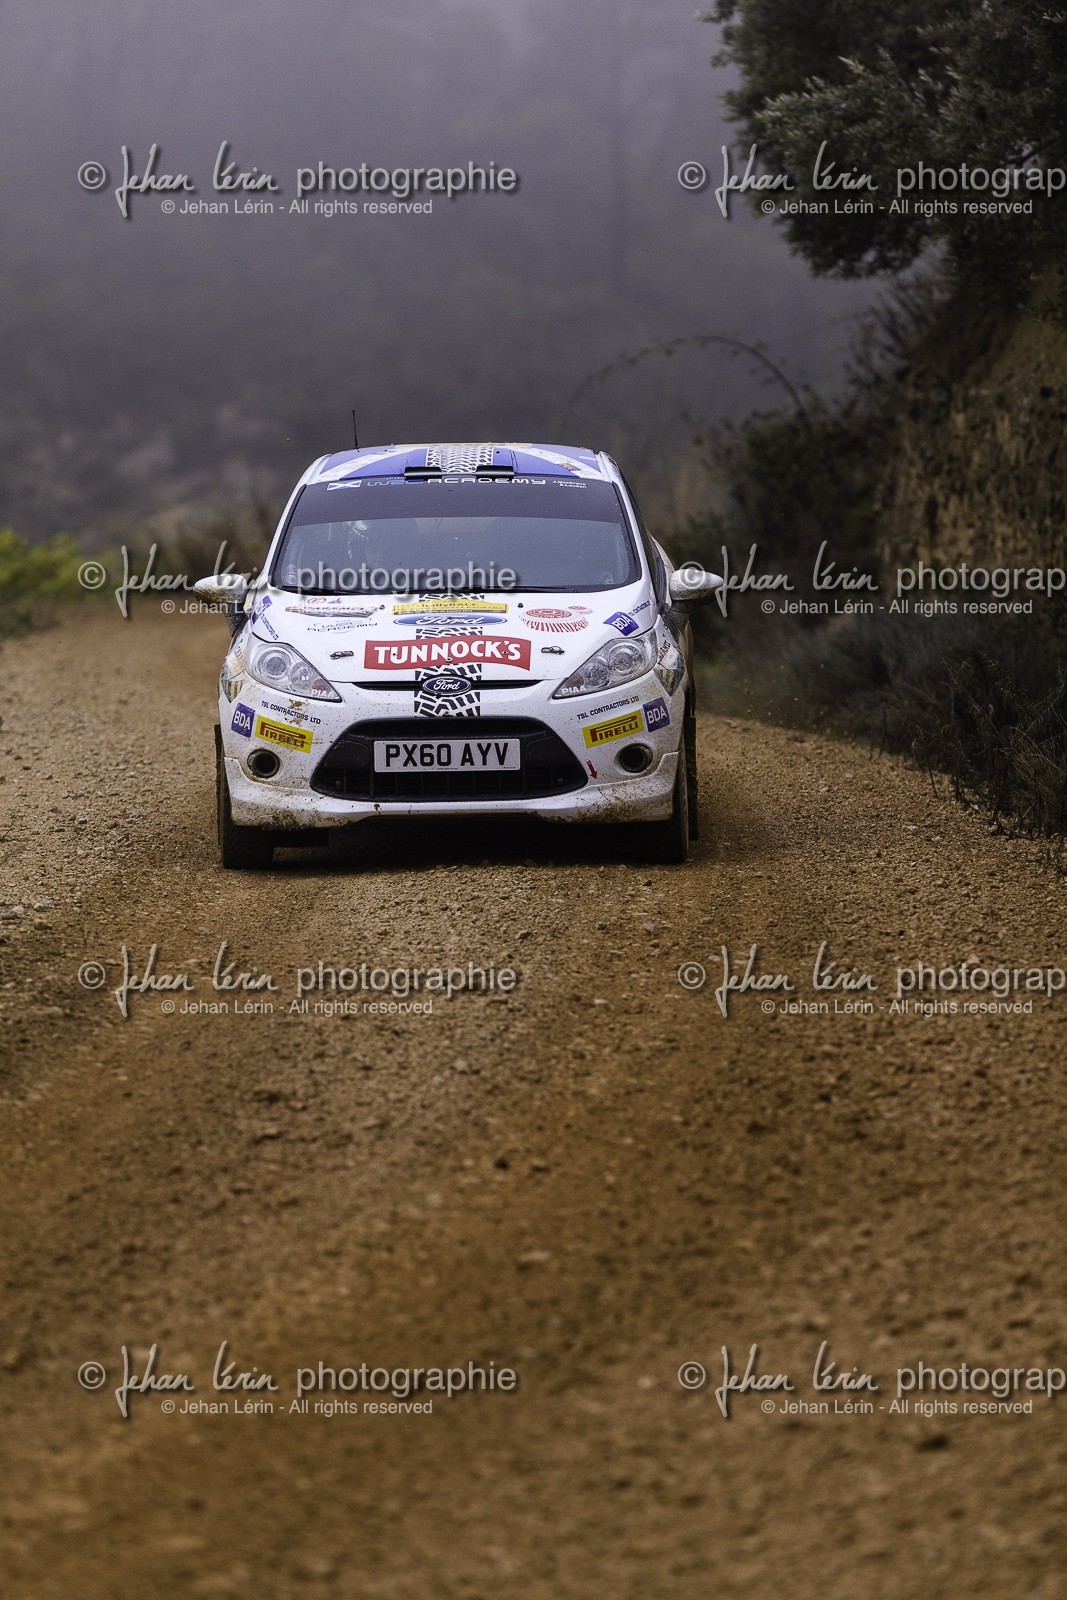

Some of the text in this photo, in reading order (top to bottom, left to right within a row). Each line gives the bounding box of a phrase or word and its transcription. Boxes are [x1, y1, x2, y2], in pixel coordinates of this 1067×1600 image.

[428, 476, 546, 484] ACADEMY
[416, 614, 485, 625] Ford
[611, 614, 633, 630] BDA
[374, 640, 521, 665] TUNNOCK'S
[434, 679, 461, 690] Ford
[561, 685, 588, 695] PIAA
[261, 700, 321, 725] TSL CONTRACTORS LTD
[590, 698, 630, 716] CONTRACTORS
[630, 695, 639, 705] LTD
[646, 705, 667, 724] BDA
[233, 710, 251, 731] BDA
[590, 715, 639, 742] PIRELLI
[260, 721, 307, 748] PIRELLI
[385, 743, 509, 767] PX60 AYV
